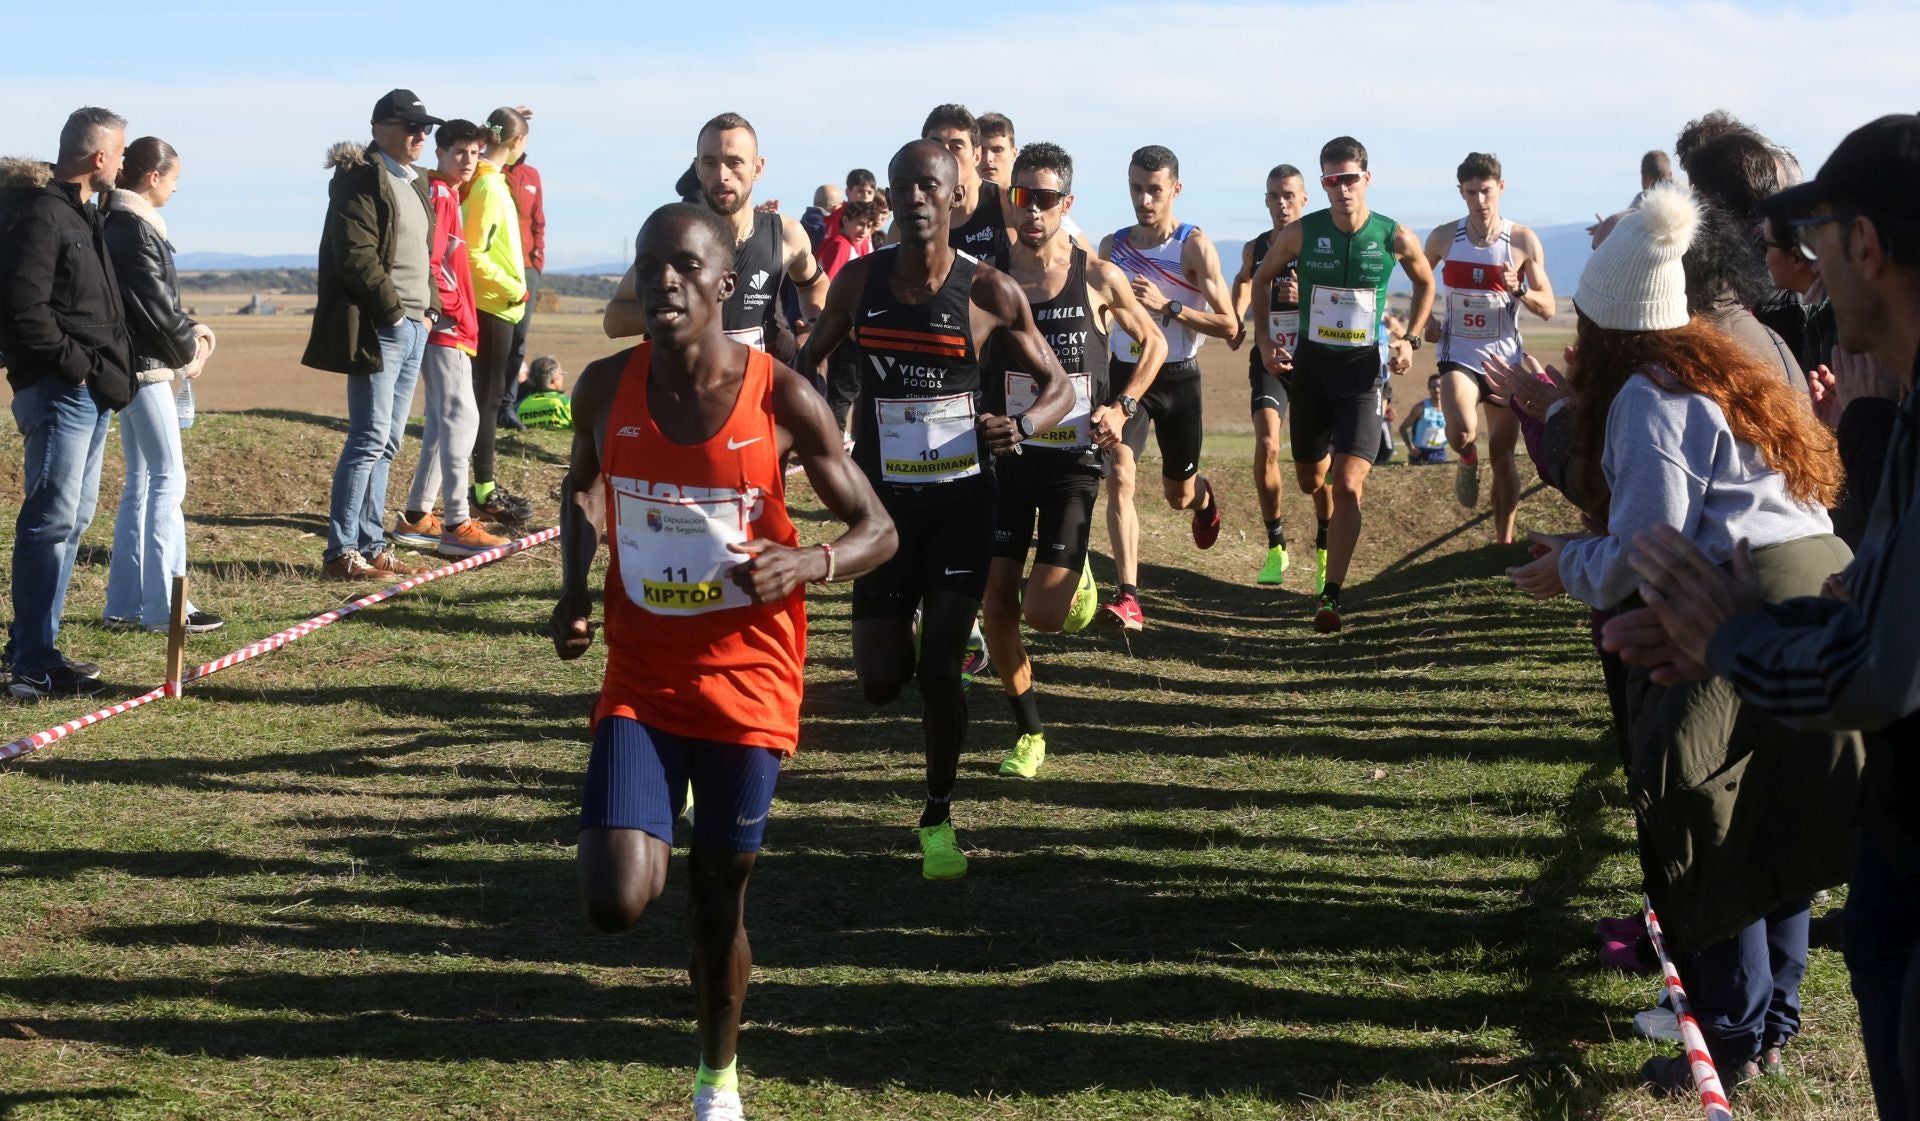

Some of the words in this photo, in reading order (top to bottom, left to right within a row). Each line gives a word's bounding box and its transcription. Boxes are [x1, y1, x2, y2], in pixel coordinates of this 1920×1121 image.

[1037, 306, 1085, 321] BIKILA
[1336, 320, 1344, 328] 6
[1463, 313, 1486, 328] 56
[1276, 332, 1297, 347] 97
[1317, 328, 1366, 339] PANIAGUA
[899, 364, 948, 379] VICKY
[903, 378, 942, 388] FOODS
[618, 426, 641, 435] ACC
[919, 449, 939, 461] 10
[886, 457, 976, 473] NAZAMBIMANA
[663, 515, 705, 526] Diputación
[663, 525, 674, 533] de
[675, 526, 706, 535] Segovia
[662, 566, 688, 583] 11
[643, 584, 722, 604] KIPTOO
